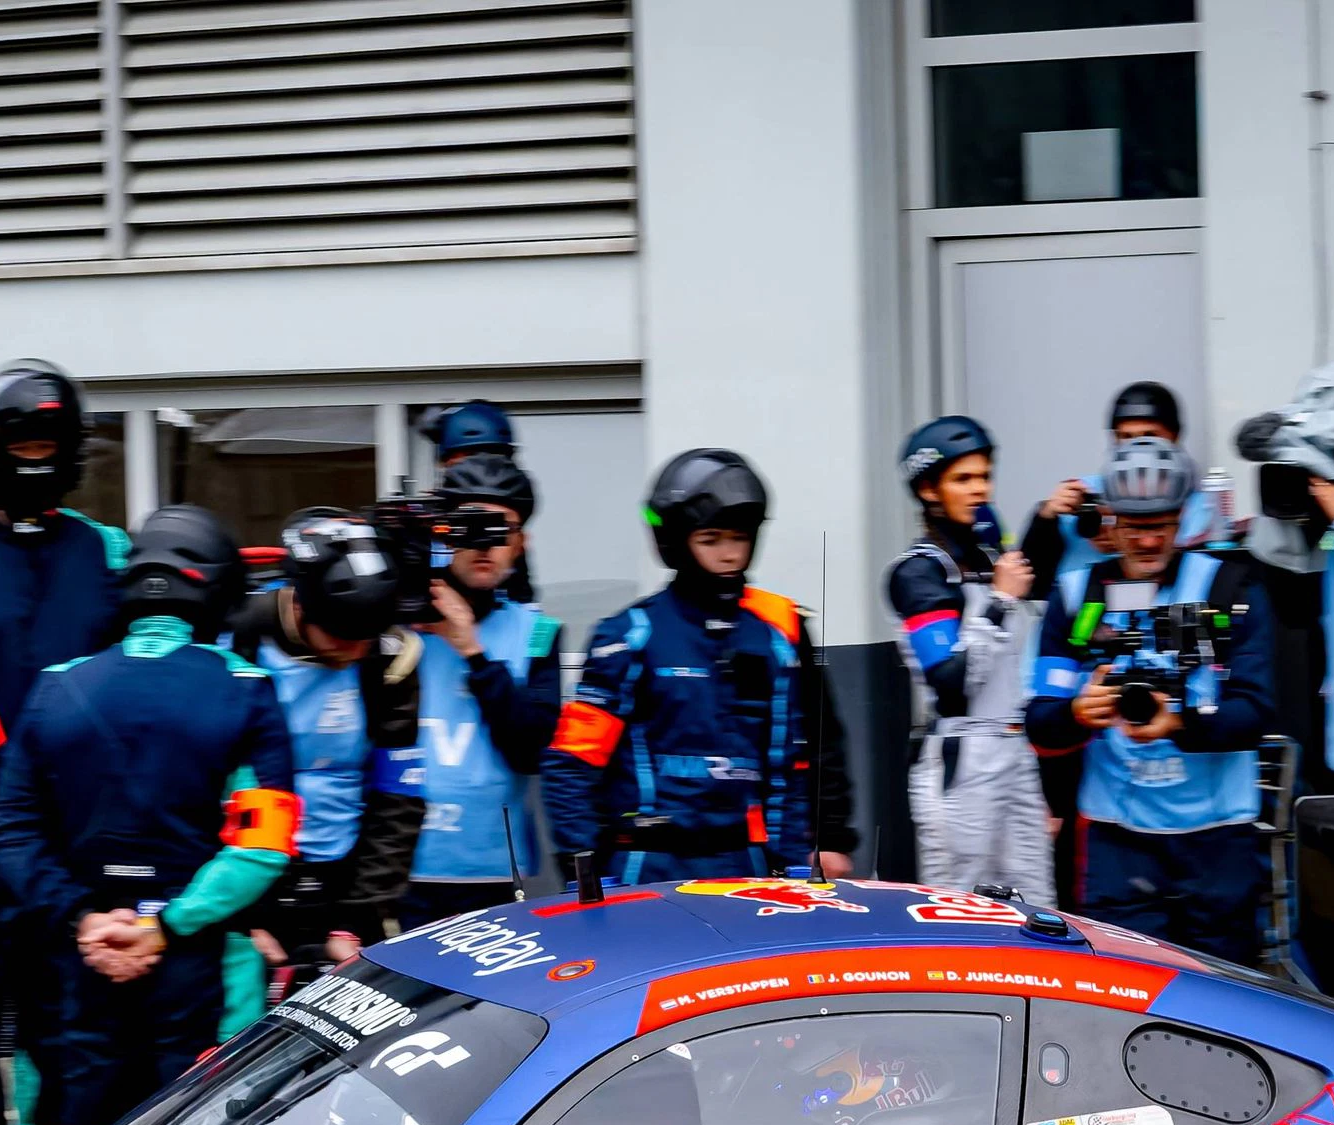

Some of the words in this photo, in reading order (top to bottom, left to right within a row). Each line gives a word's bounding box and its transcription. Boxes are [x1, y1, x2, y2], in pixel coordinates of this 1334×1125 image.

[427, 917, 557, 977] viaplay
[843, 971, 910, 983] GOUNON
[947, 970, 962, 982] D.
[965, 971, 1062, 989] JUNCADELLA
[697, 977, 789, 1003] VERSTAPPEN
[1092, 982, 1105, 994] L.
[1109, 986, 1149, 1000] AUER
[313, 1016, 360, 1051] SIMULATOR
